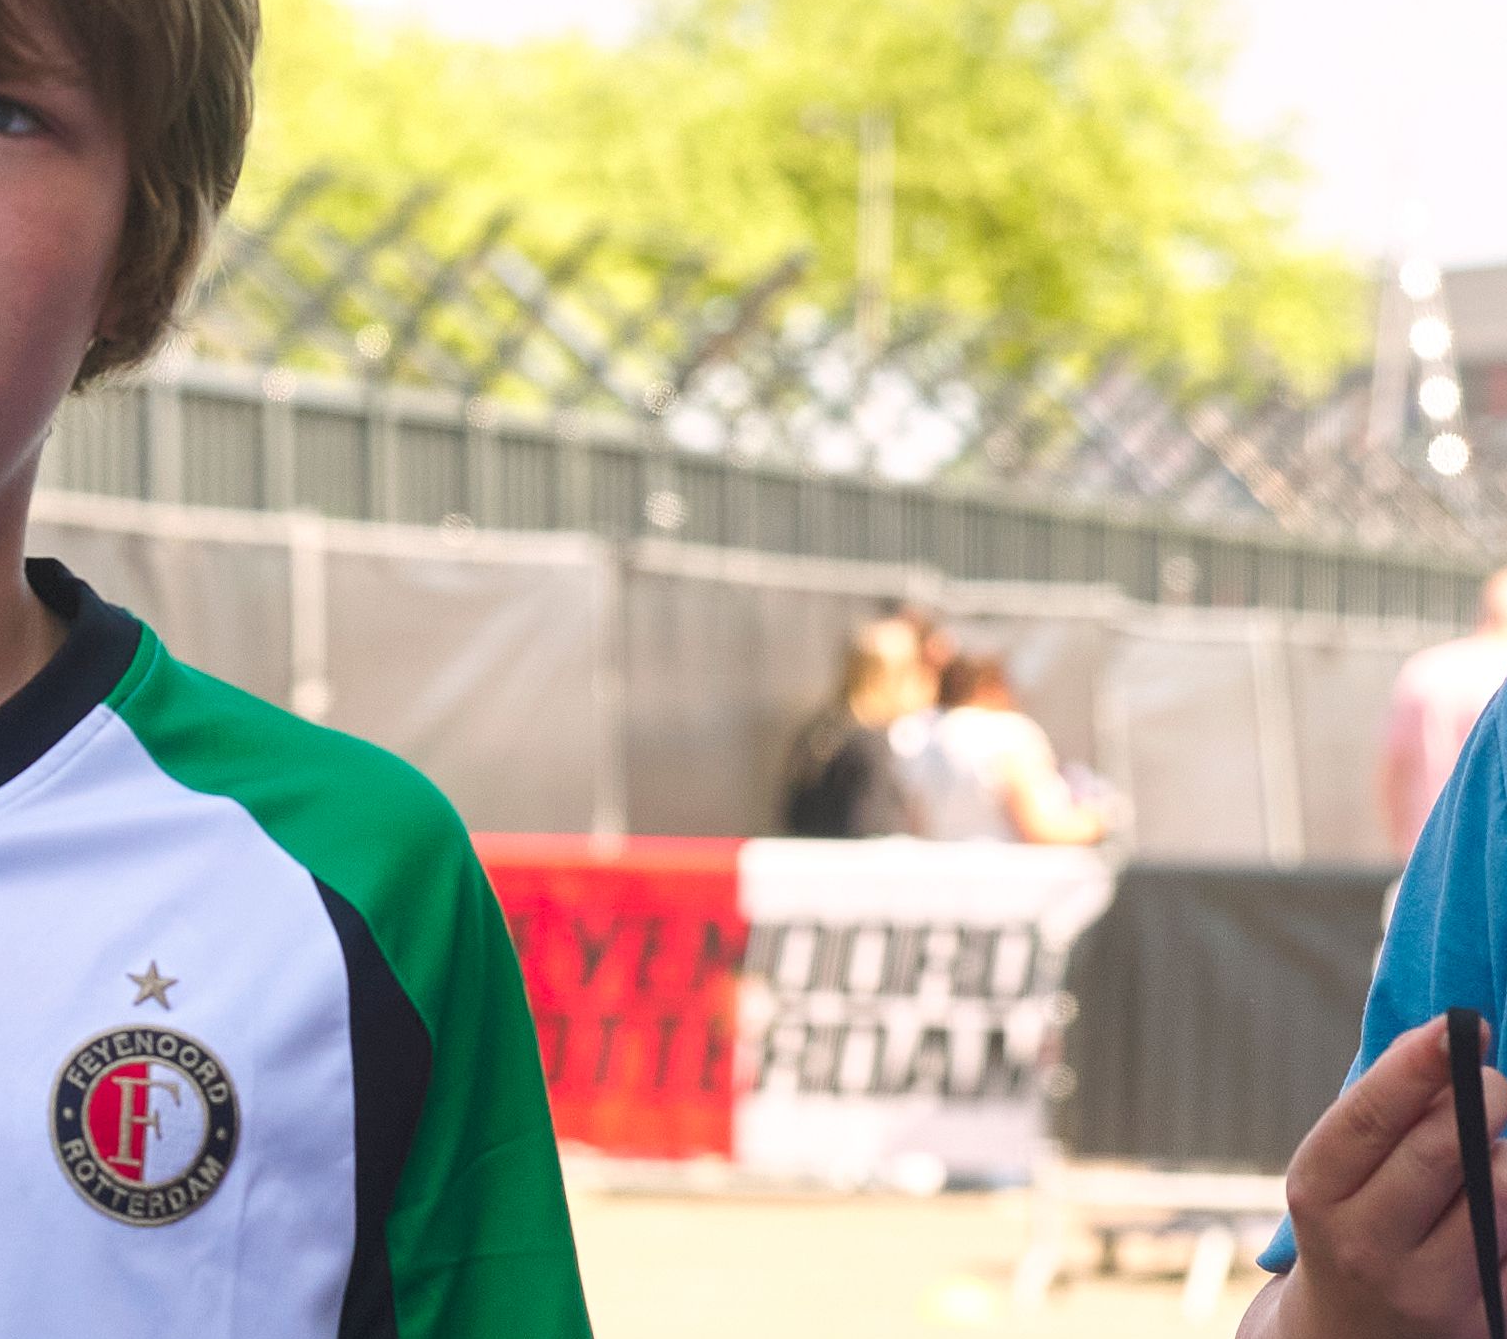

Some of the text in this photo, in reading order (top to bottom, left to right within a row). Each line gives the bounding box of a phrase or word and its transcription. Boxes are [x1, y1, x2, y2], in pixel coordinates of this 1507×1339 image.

[65, 1030, 229, 1104] FEYENOORD
[107, 1075, 181, 1167] F
[60, 1137, 226, 1217] ROTTERDAM
